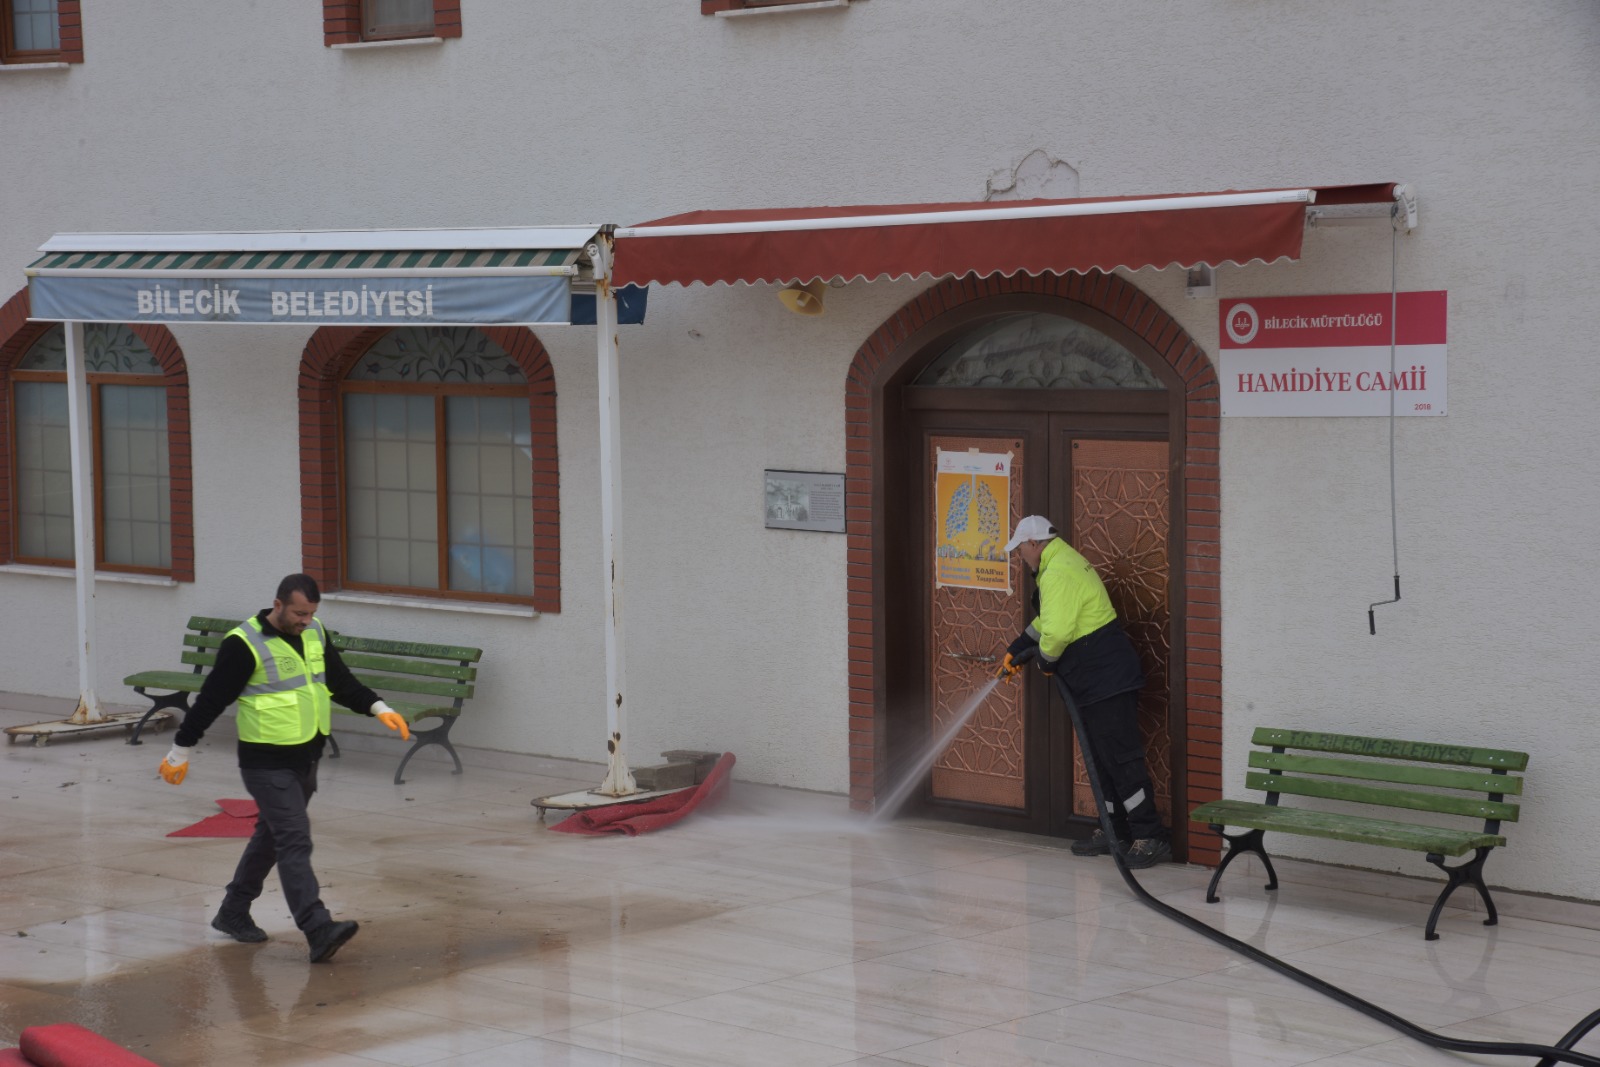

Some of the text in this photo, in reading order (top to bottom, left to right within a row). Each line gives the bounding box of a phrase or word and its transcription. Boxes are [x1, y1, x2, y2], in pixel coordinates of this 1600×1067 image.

[137, 283, 434, 316] BİLECİK BELEDİYESİ
[1264, 313, 1383, 329] BİLECİK MÜFTÜLÜĞÜ
[1237, 365, 1427, 393] HAMİDİYE CAMİİ
[1414, 403, 1431, 411] 2018
[1290, 731, 1313, 746] T.C.
